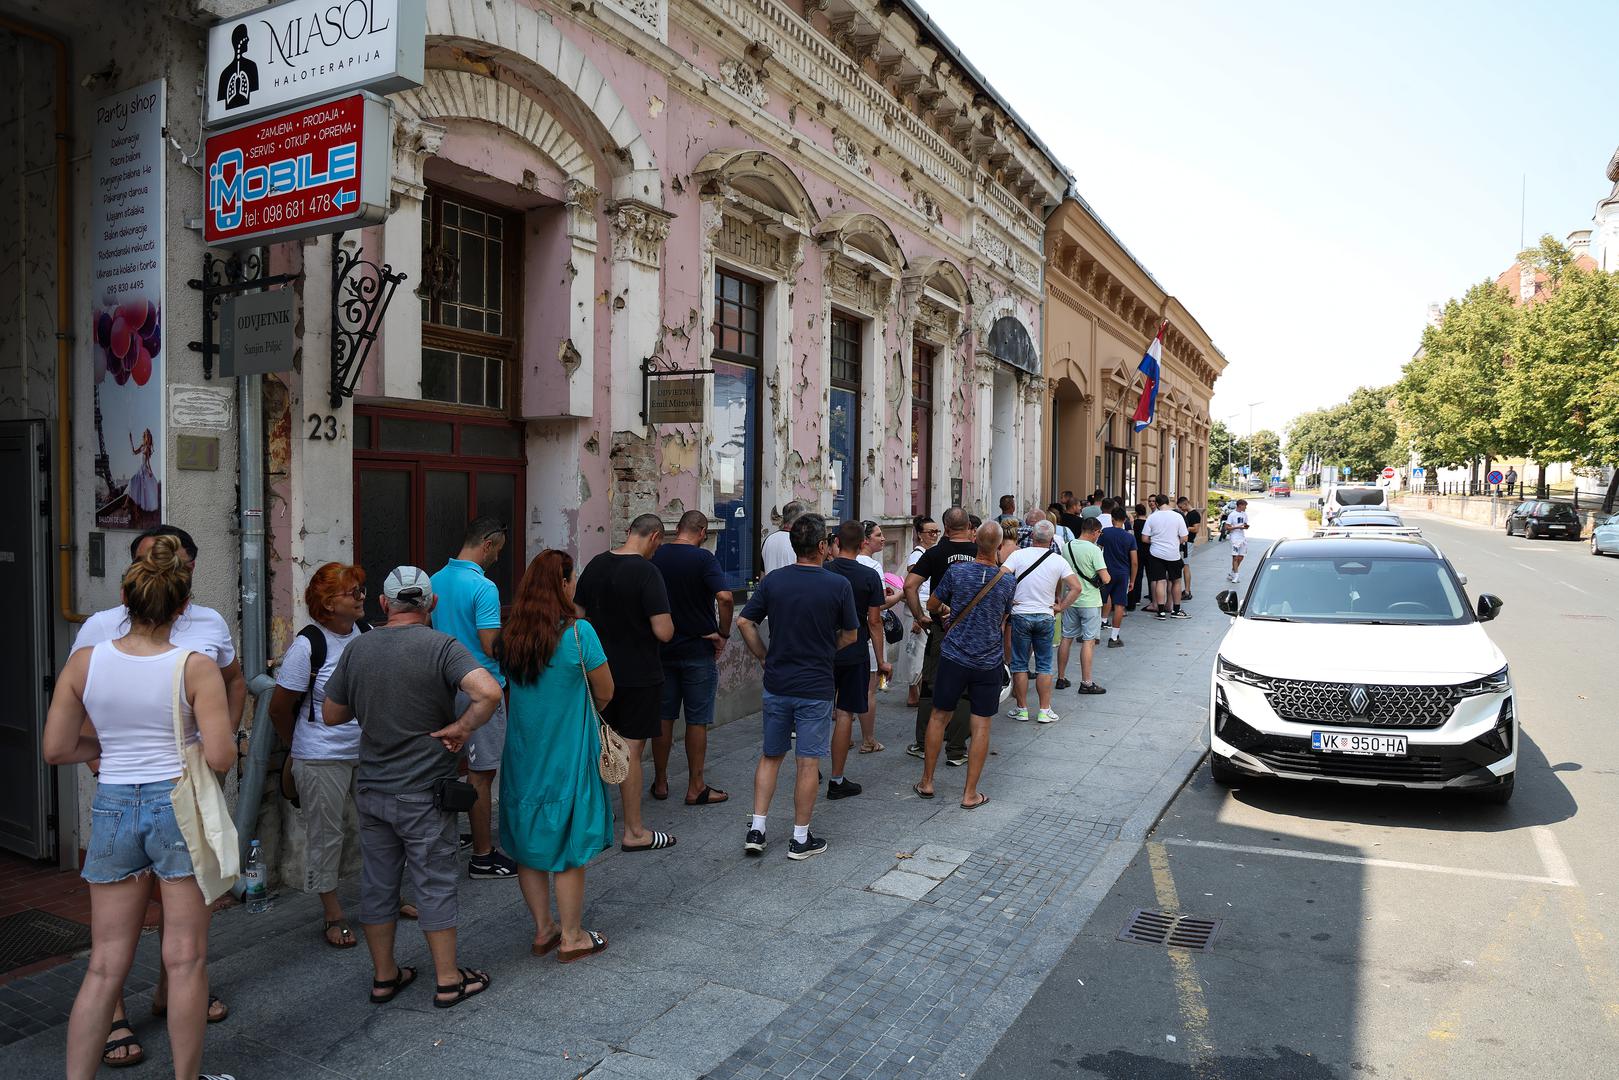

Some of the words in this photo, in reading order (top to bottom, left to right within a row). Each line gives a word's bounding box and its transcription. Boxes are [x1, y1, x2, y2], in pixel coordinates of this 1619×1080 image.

[260, 0, 390, 67] MIASOL
[274, 50, 380, 87] HALOTERAPIJA
[97, 102, 128, 131] Party
[131, 94, 156, 114] shop
[260, 121, 293, 140] ZAMJENA
[302, 111, 339, 127] PRODAJA
[249, 143, 275, 158] SERVIS
[284, 133, 310, 149] OTKUP
[319, 124, 352, 141] OPREMA
[244, 212, 260, 228] tel:
[262, 205, 283, 224] 098
[285, 200, 305, 219] 681
[309, 194, 331, 213] 478
[139, 259, 157, 271] torte
[237, 309, 290, 331] ODVJETNIK
[651, 399, 667, 408] Emil
[1322, 735, 1339, 749] VK
[1351, 736, 1405, 753] 950-HA
